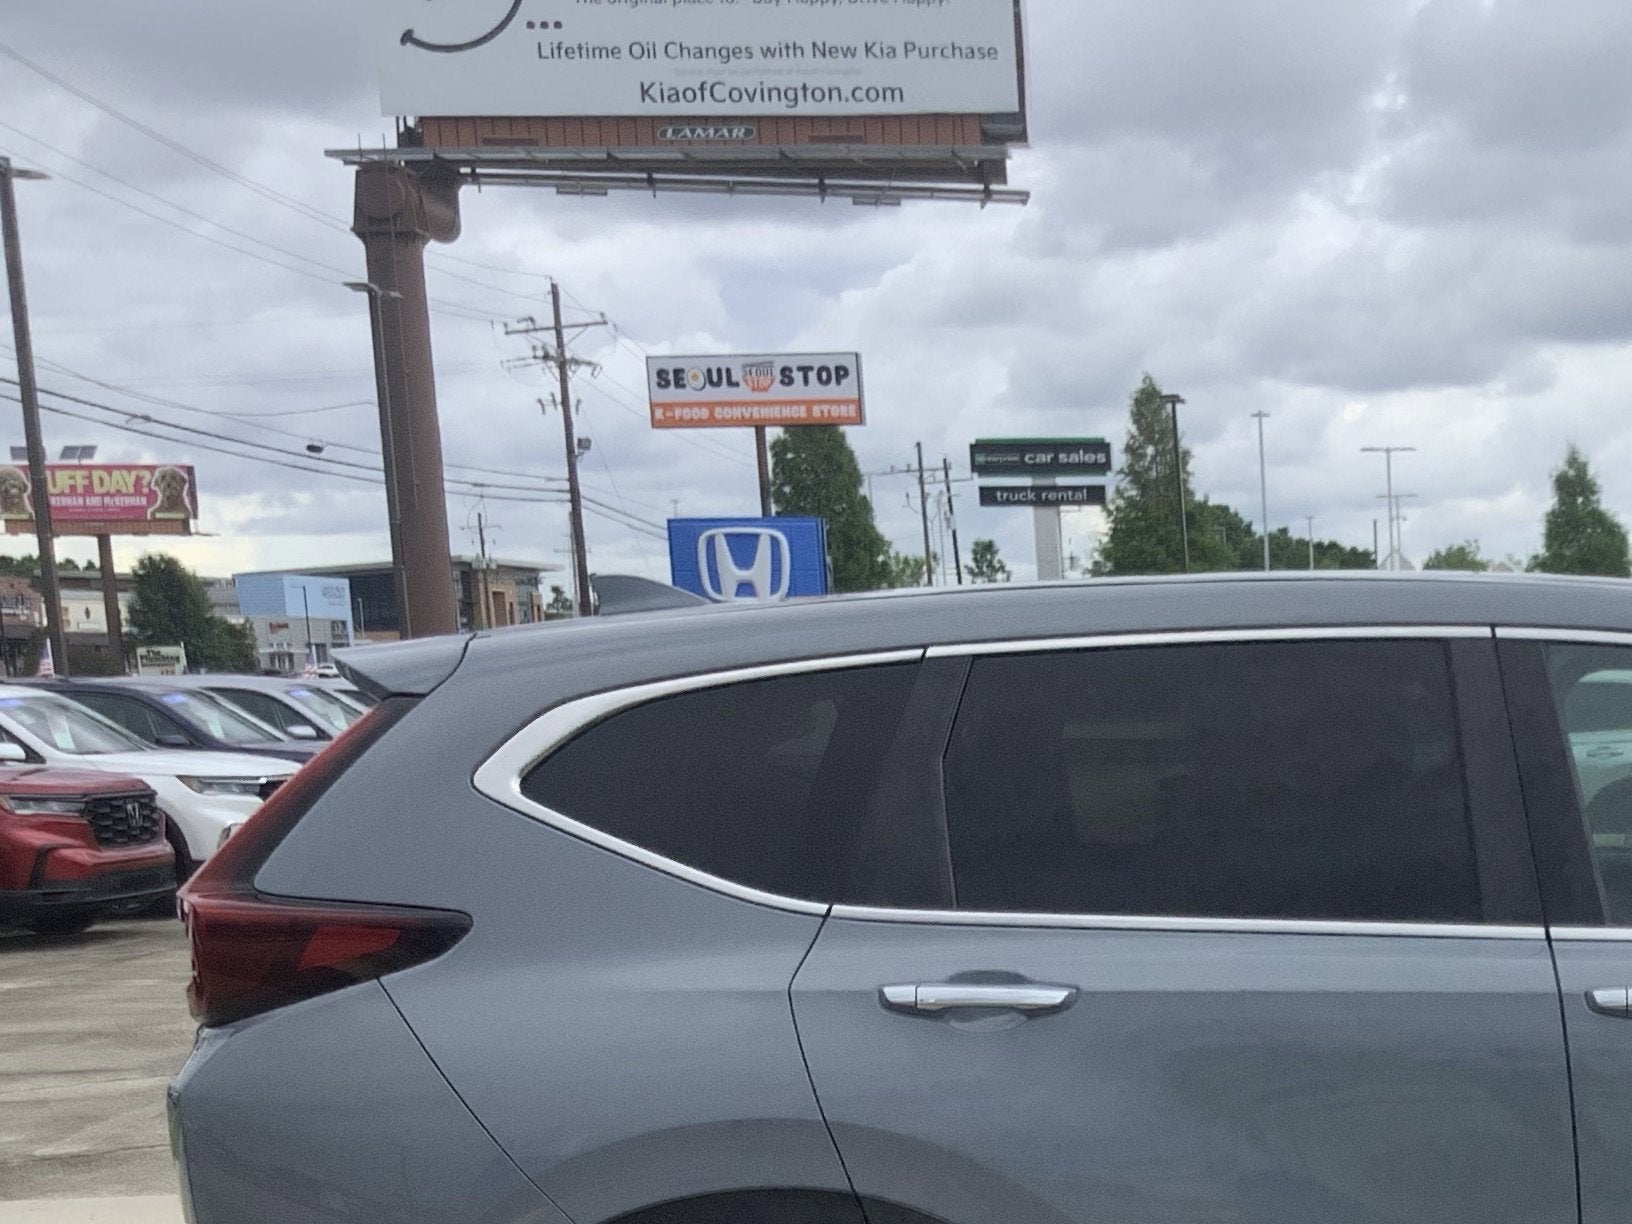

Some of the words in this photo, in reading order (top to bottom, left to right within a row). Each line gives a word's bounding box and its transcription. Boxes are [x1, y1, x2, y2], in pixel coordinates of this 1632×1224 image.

[537, 40, 622, 60] Lifetime
[628, 41, 657, 60] Oil
[663, 40, 754, 65] Changes
[760, 40, 805, 60] with
[812, 41, 858, 60] New
[864, 40, 897, 60] Kia
[904, 40, 999, 61] Purchase
[639, 79, 904, 105] KiaofCovington.com
[665, 127, 746, 139] LAMAR
[780, 364, 850, 388] STOP
[714, 404, 807, 420] CONVENIENCE
[812, 403, 857, 418] STORE
[1024, 452, 1054, 464] car
[1058, 449, 1107, 464] sales
[46, 469, 90, 495] UFF
[91, 469, 152, 495] DAY?
[995, 488, 1036, 502] truck
[1041, 487, 1088, 502] rental
